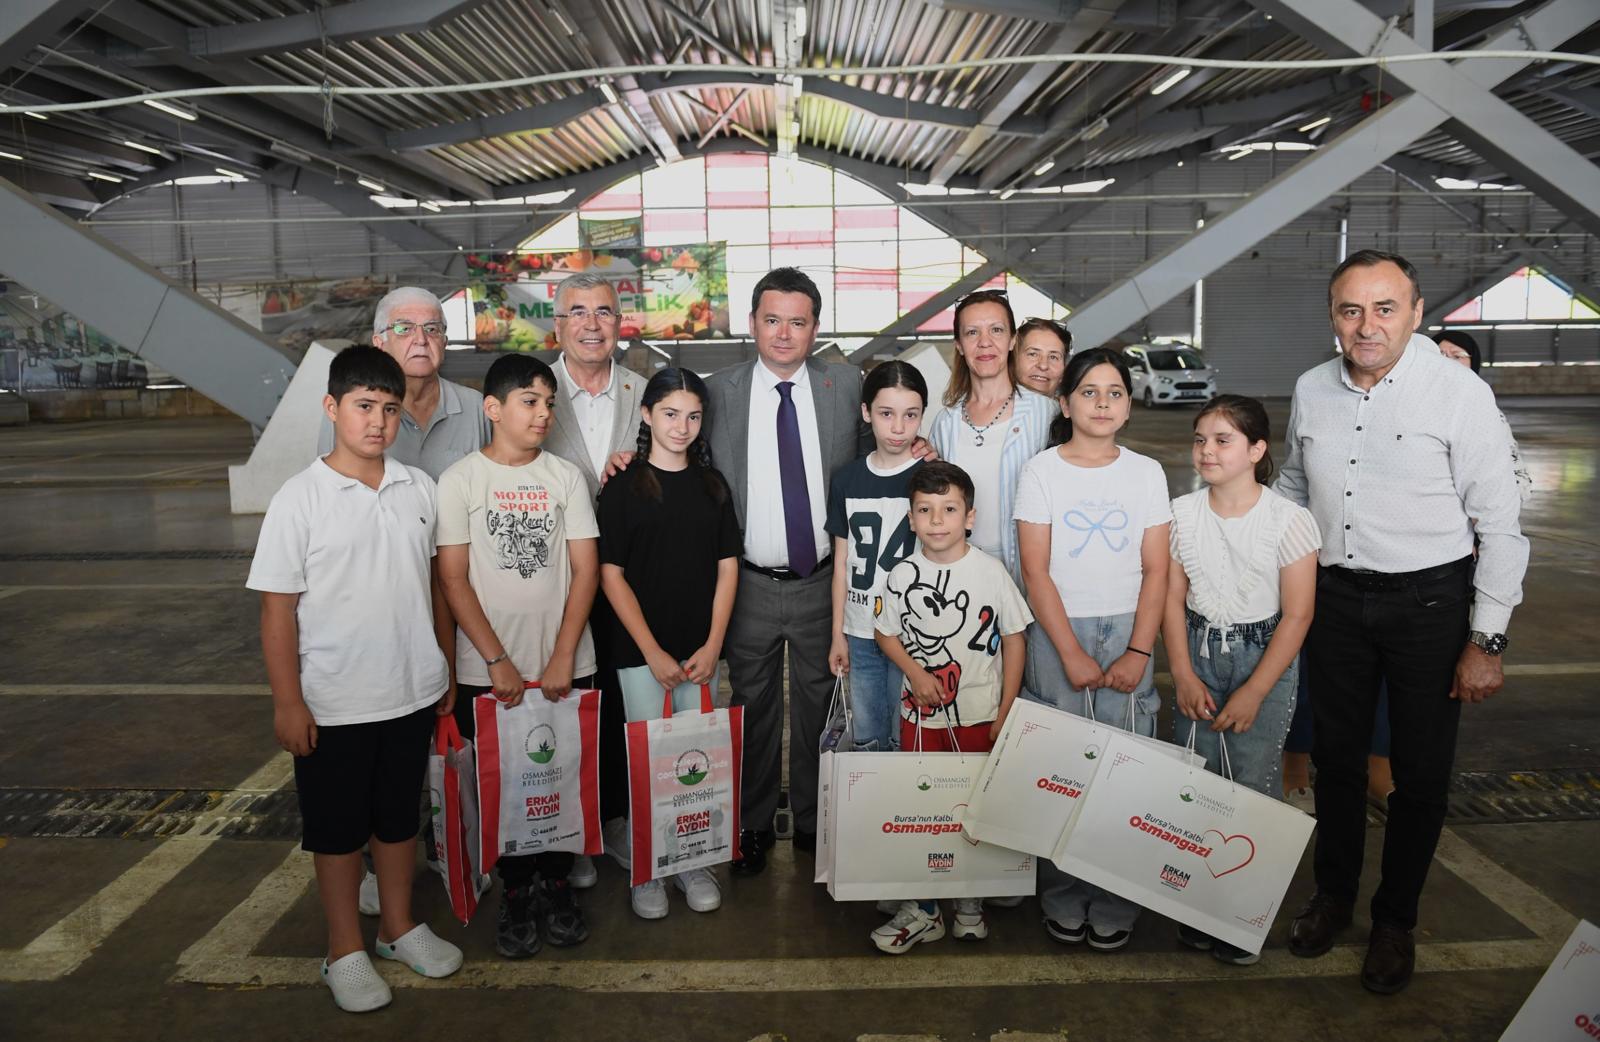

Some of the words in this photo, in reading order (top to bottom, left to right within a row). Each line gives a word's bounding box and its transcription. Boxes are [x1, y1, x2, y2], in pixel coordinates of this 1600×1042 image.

[494, 491, 548, 500] MOTOR
[498, 502, 549, 511] SPORT
[848, 590, 869, 606] TEAM
[526, 792, 560, 807] ERKAN
[526, 802, 560, 817] AYDIN
[676, 810, 710, 825] ERKAN
[932, 814, 953, 823] Kalbi
[677, 819, 710, 834] AYDIN
[882, 822, 963, 835] Osmangazi
[1129, 815, 1213, 858] Osmangazi
[1183, 830, 1204, 844] Kalbi
[928, 859, 953, 867] AYDIN
[1160, 871, 1188, 888] AYDIN
[1163, 864, 1191, 880] ERKAN
